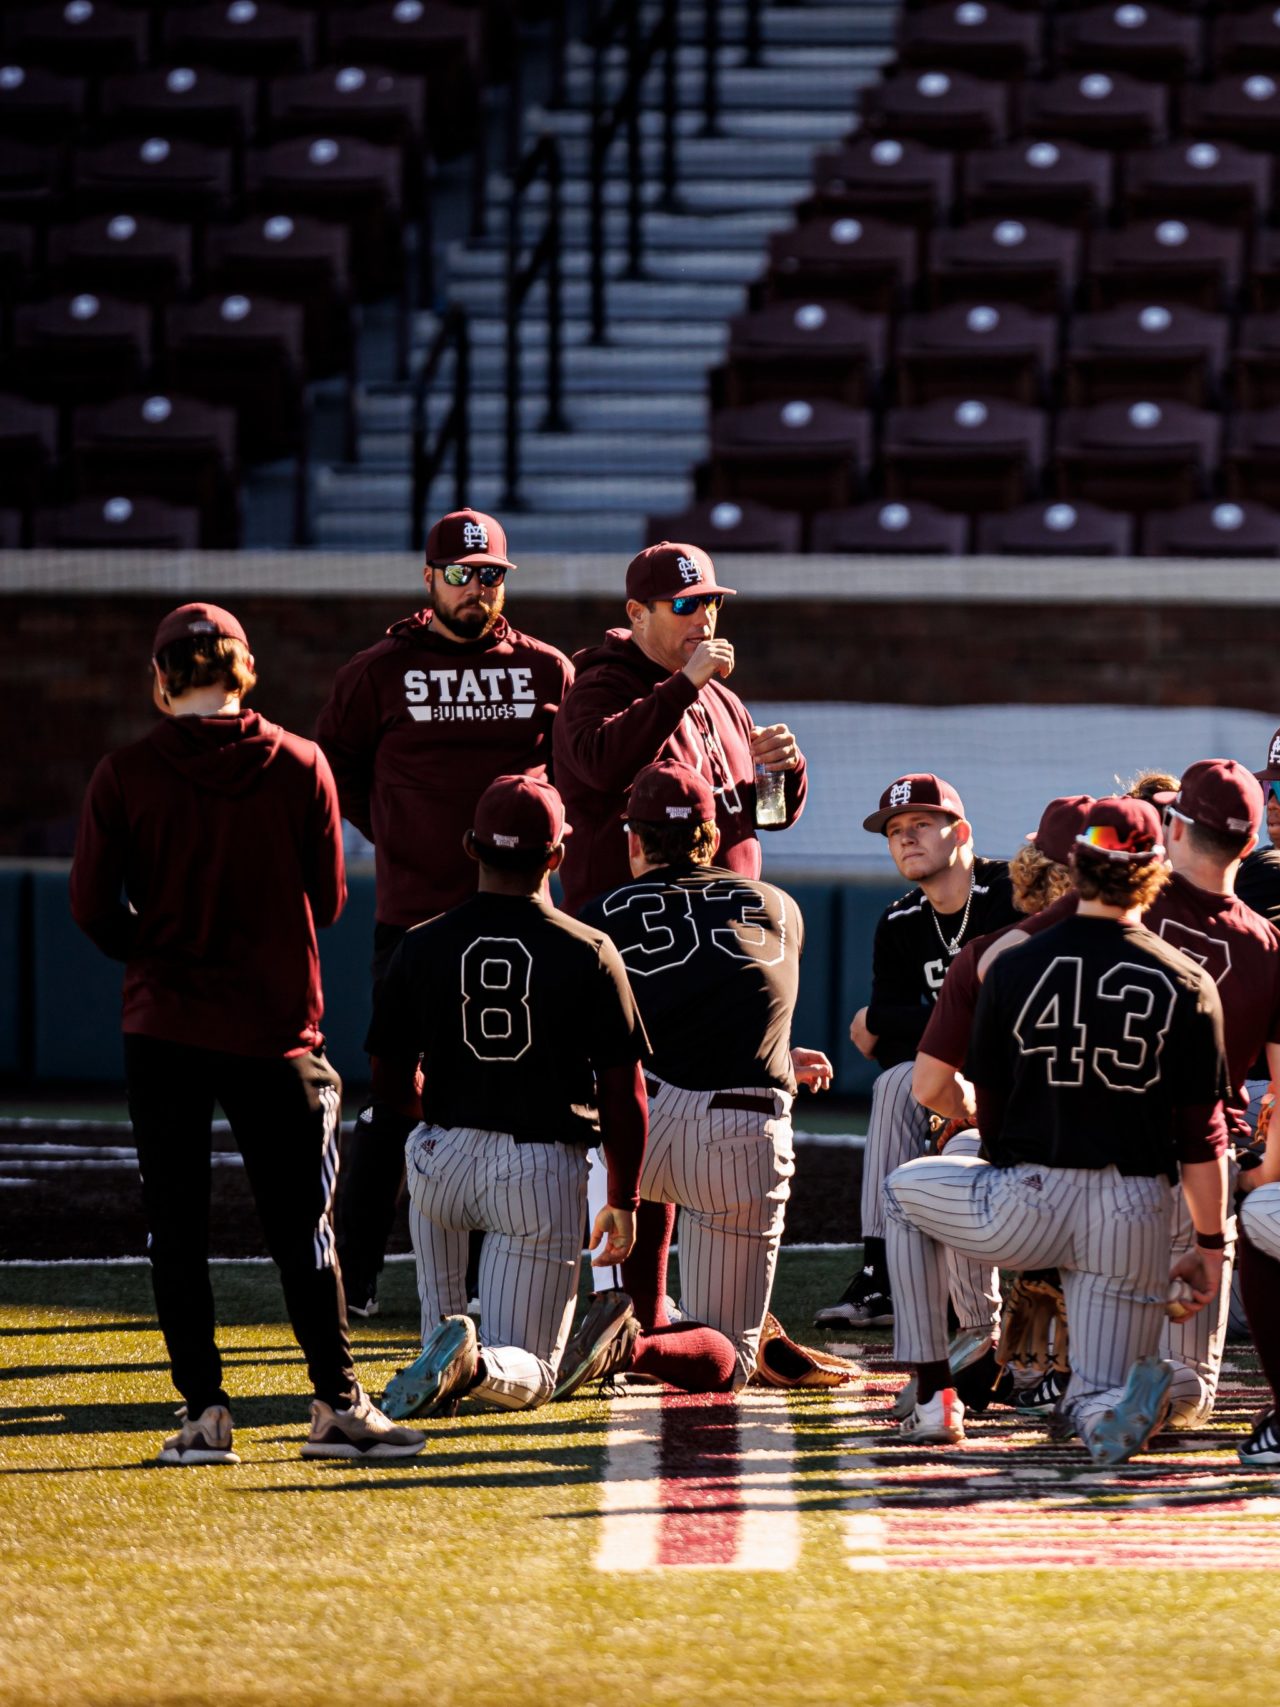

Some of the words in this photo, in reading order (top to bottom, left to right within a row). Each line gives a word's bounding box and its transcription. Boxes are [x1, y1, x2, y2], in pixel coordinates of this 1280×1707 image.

[404, 667, 537, 703] STATE
[431, 703, 517, 721] BULLDOGS
[603, 880, 786, 976] 33
[461, 936, 532, 1061] 8
[1013, 956, 1177, 1092] 43
